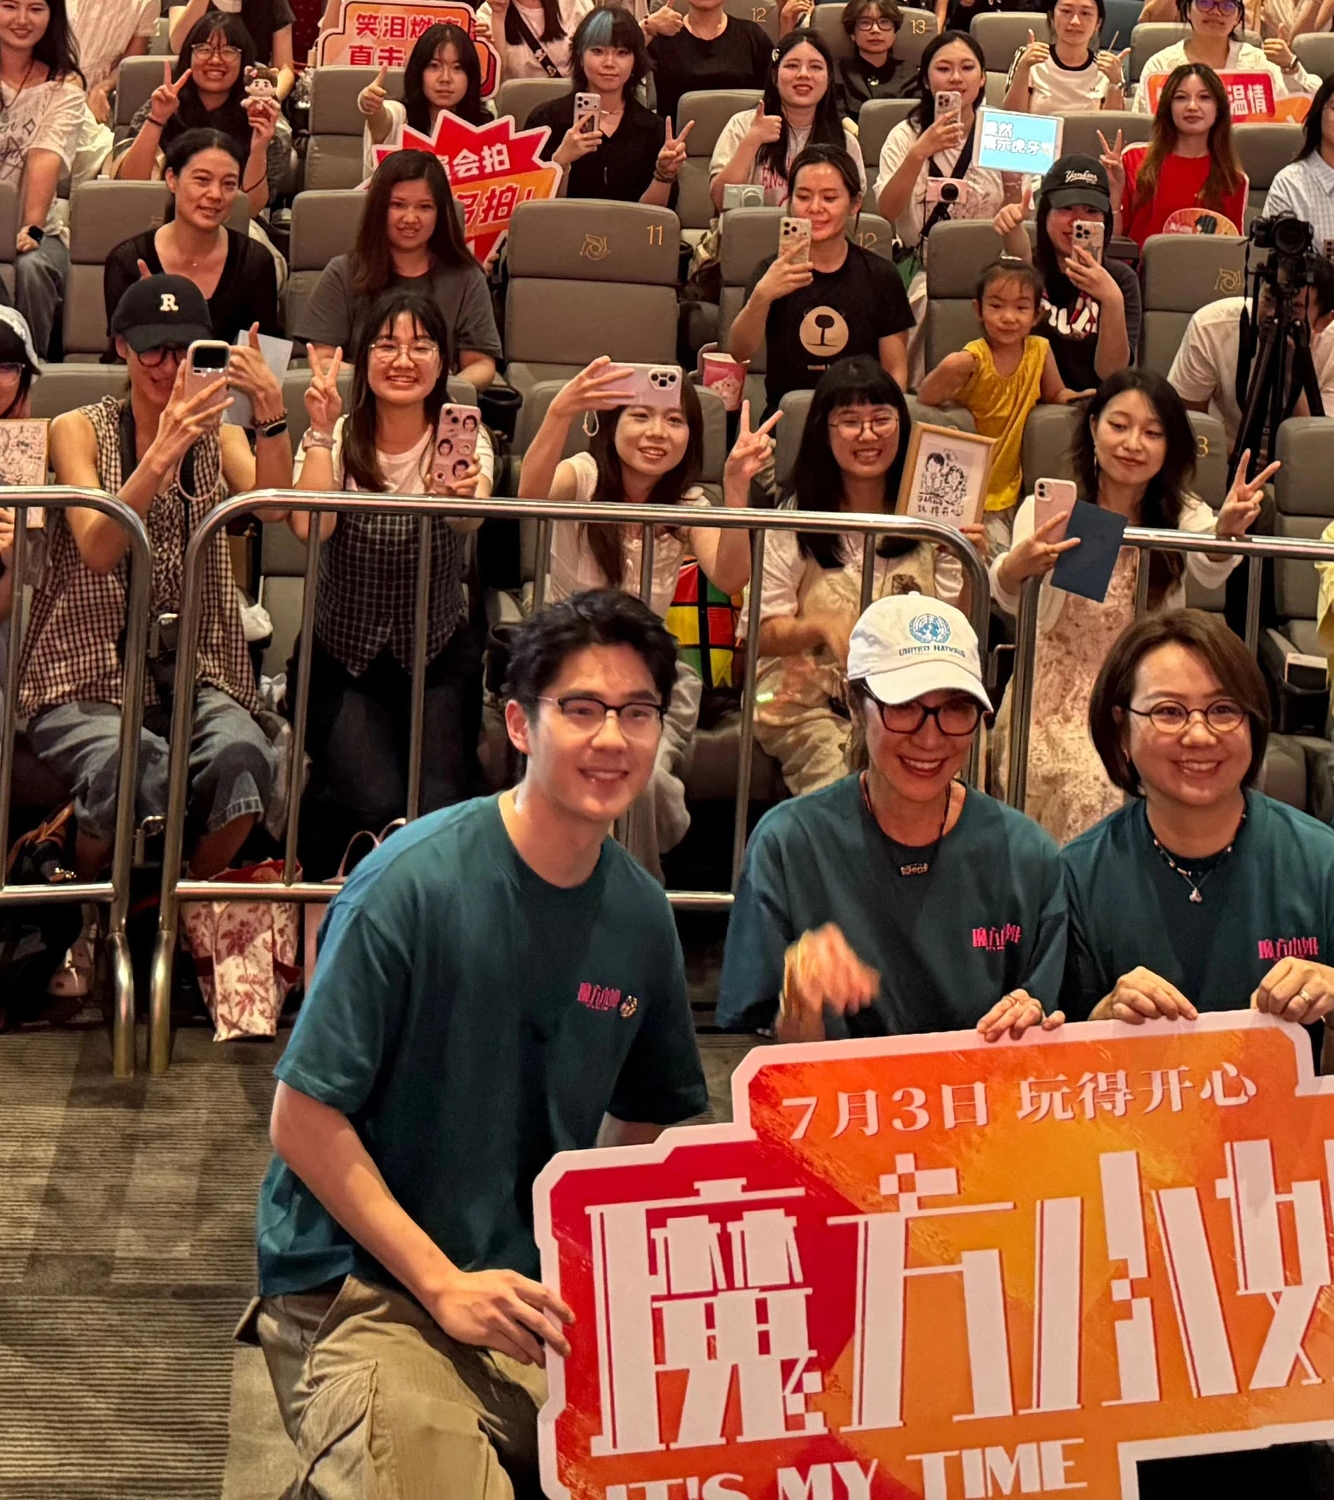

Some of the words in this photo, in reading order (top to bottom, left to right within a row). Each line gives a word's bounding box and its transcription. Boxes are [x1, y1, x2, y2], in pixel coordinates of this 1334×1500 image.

[752, 9, 766, 22] 12
[355, 12, 462, 39] 笑泪燃
[910, 19, 926, 34] 13
[647, 225, 663, 245] 11
[160, 293, 179, 312] R
[898, 646, 929, 656] UNITED
[782, 1080, 989, 1140] 7月3日
[1016, 1062, 1258, 1123] 玩得开心
[906, 1438, 1089, 1500] TIME
